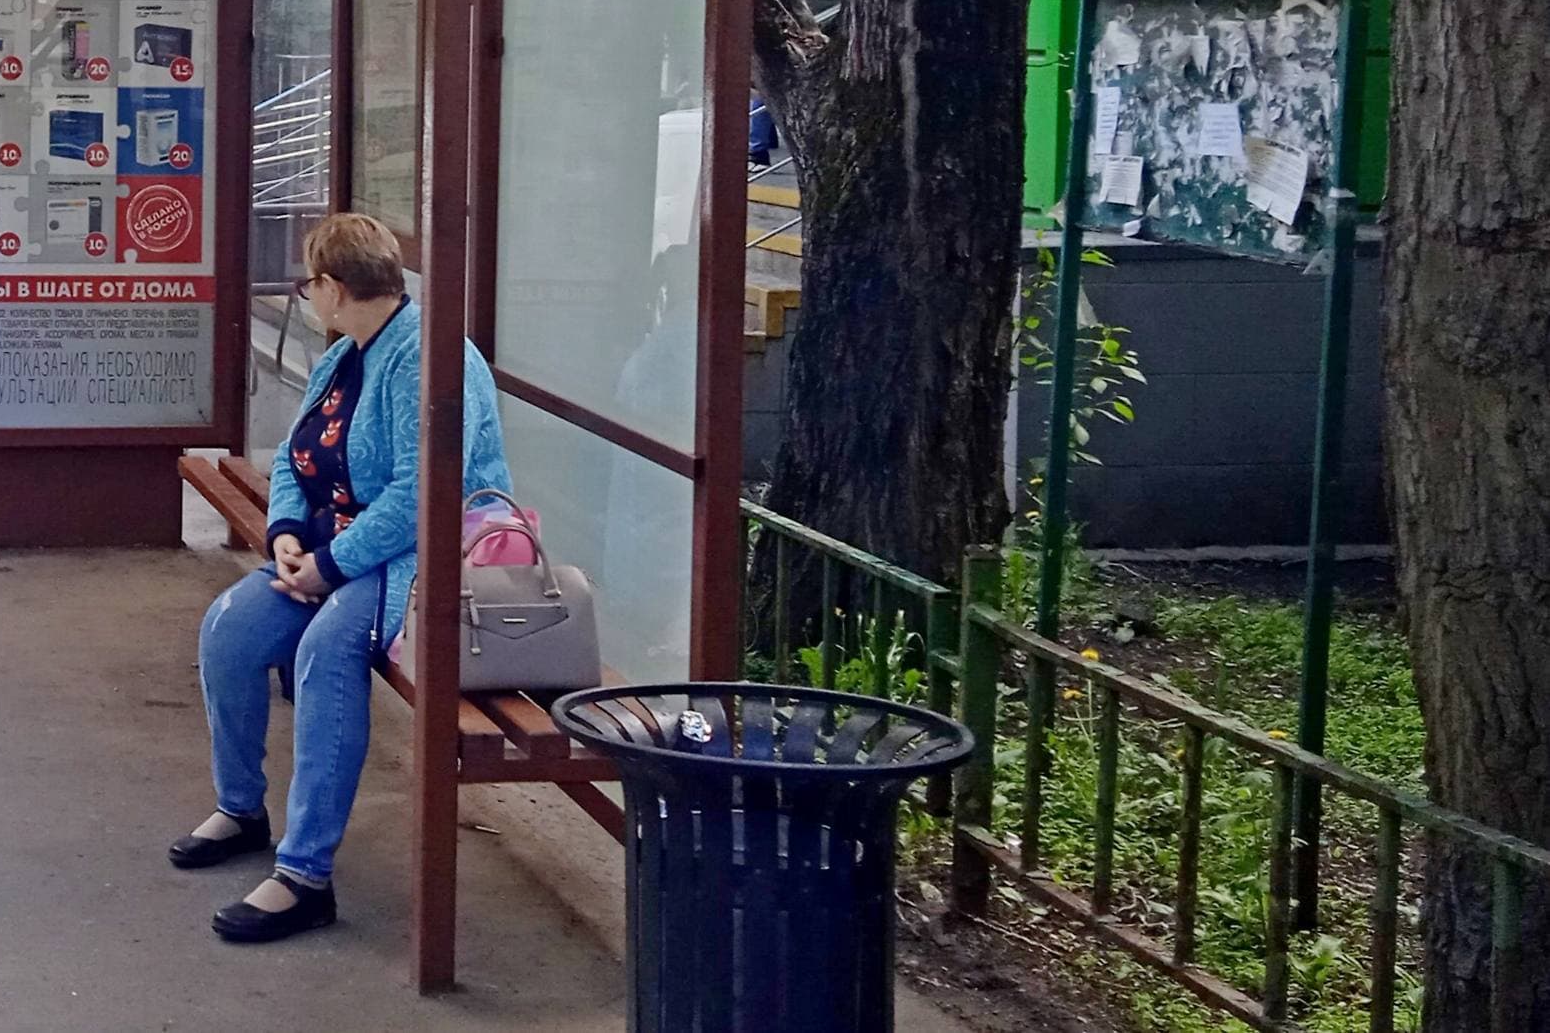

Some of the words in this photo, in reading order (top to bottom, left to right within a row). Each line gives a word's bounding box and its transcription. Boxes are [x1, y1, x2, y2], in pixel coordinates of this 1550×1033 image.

[133, 199, 183, 231] СДЕЛАНО
[148, 207, 187, 235] РОССИИ
[18, 283, 30, 297] В
[37, 282, 93, 298] ШАГЕ
[99, 282, 125, 298] ОТ
[131, 282, 196, 300] ДОМА
[96, 352, 196, 377] НЕОБХОДИМО
[87, 379, 195, 405] СПЕЦИАЛИСТА
